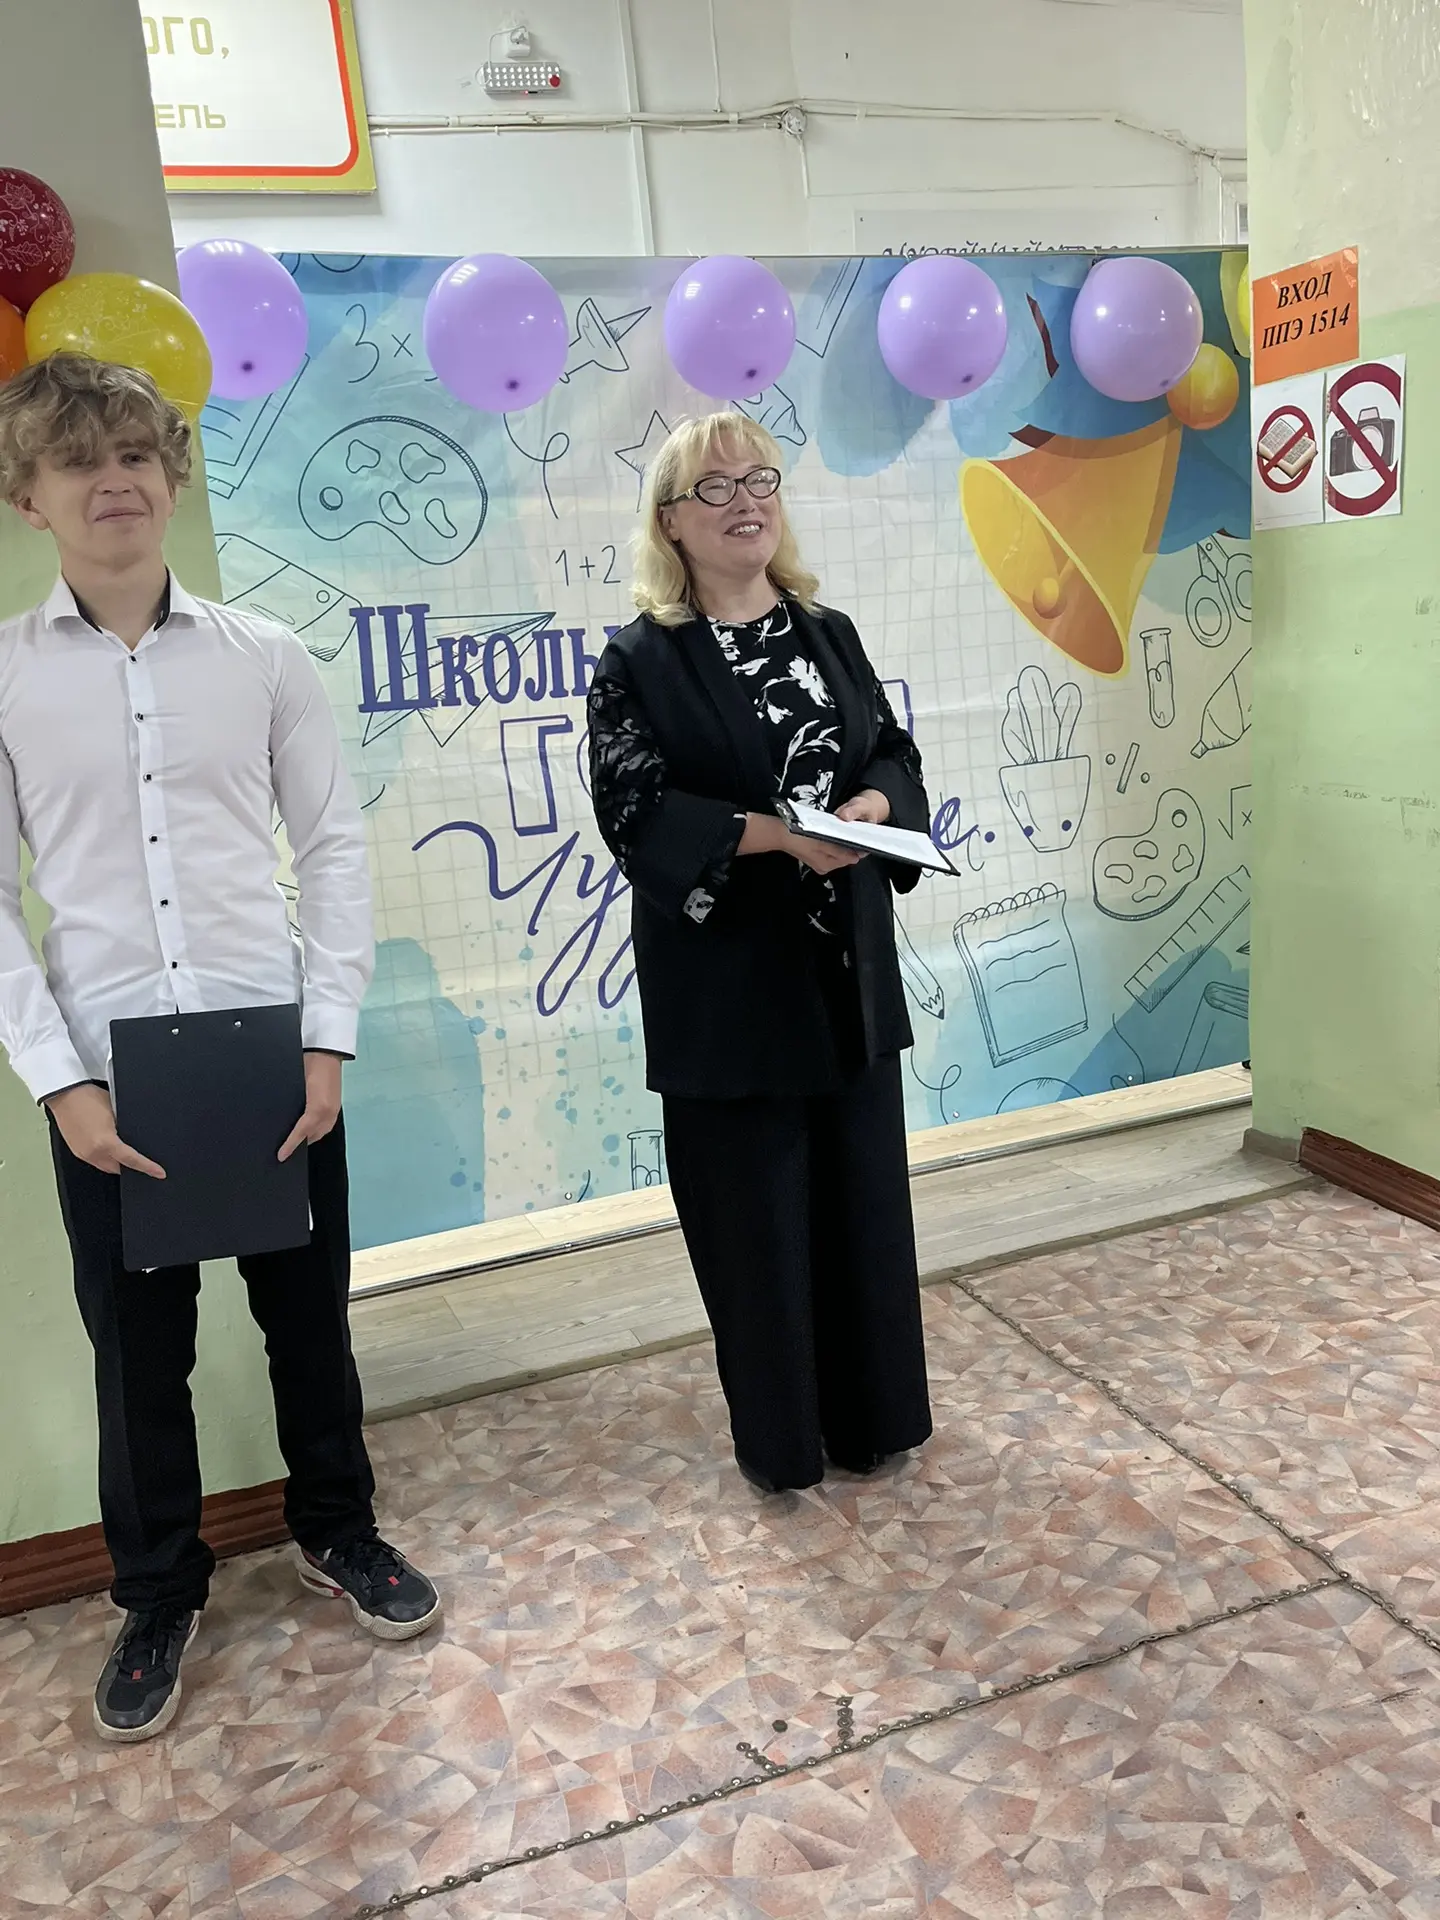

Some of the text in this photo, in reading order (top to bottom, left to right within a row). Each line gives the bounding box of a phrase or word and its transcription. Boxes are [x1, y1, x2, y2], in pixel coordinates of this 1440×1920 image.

[1277, 271, 1333, 310] ВХОД
[1261, 302, 1351, 350] ППЭ 1514
[555, 544, 621, 586] 1+2
[348, 603, 627, 713] Школь
